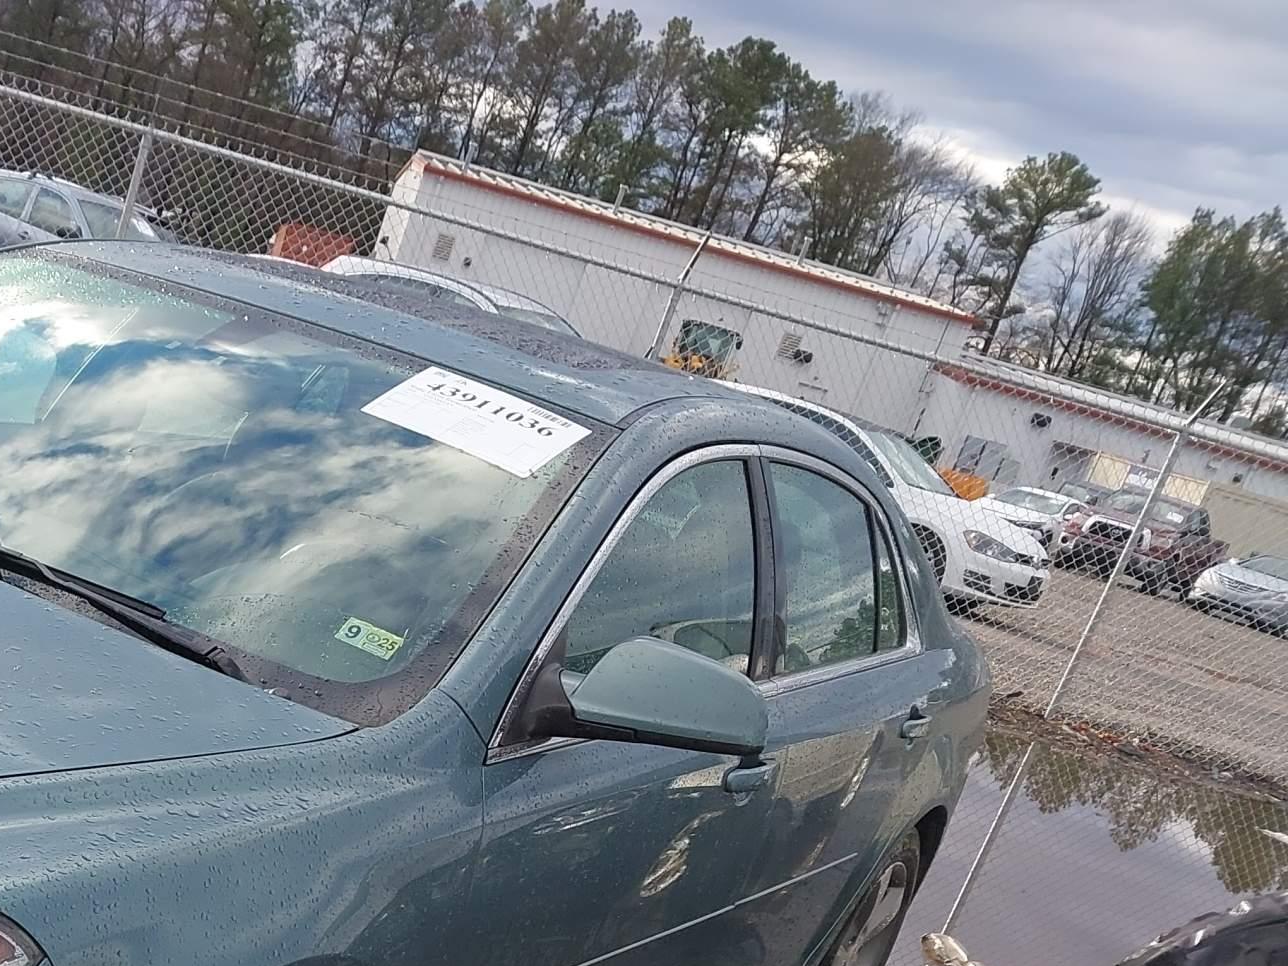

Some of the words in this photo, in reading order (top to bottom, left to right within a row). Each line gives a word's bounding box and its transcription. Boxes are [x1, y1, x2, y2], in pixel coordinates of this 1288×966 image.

[426, 382, 554, 437] 43911036
[345, 625, 361, 638] 9
[378, 638, 398, 651] 25
